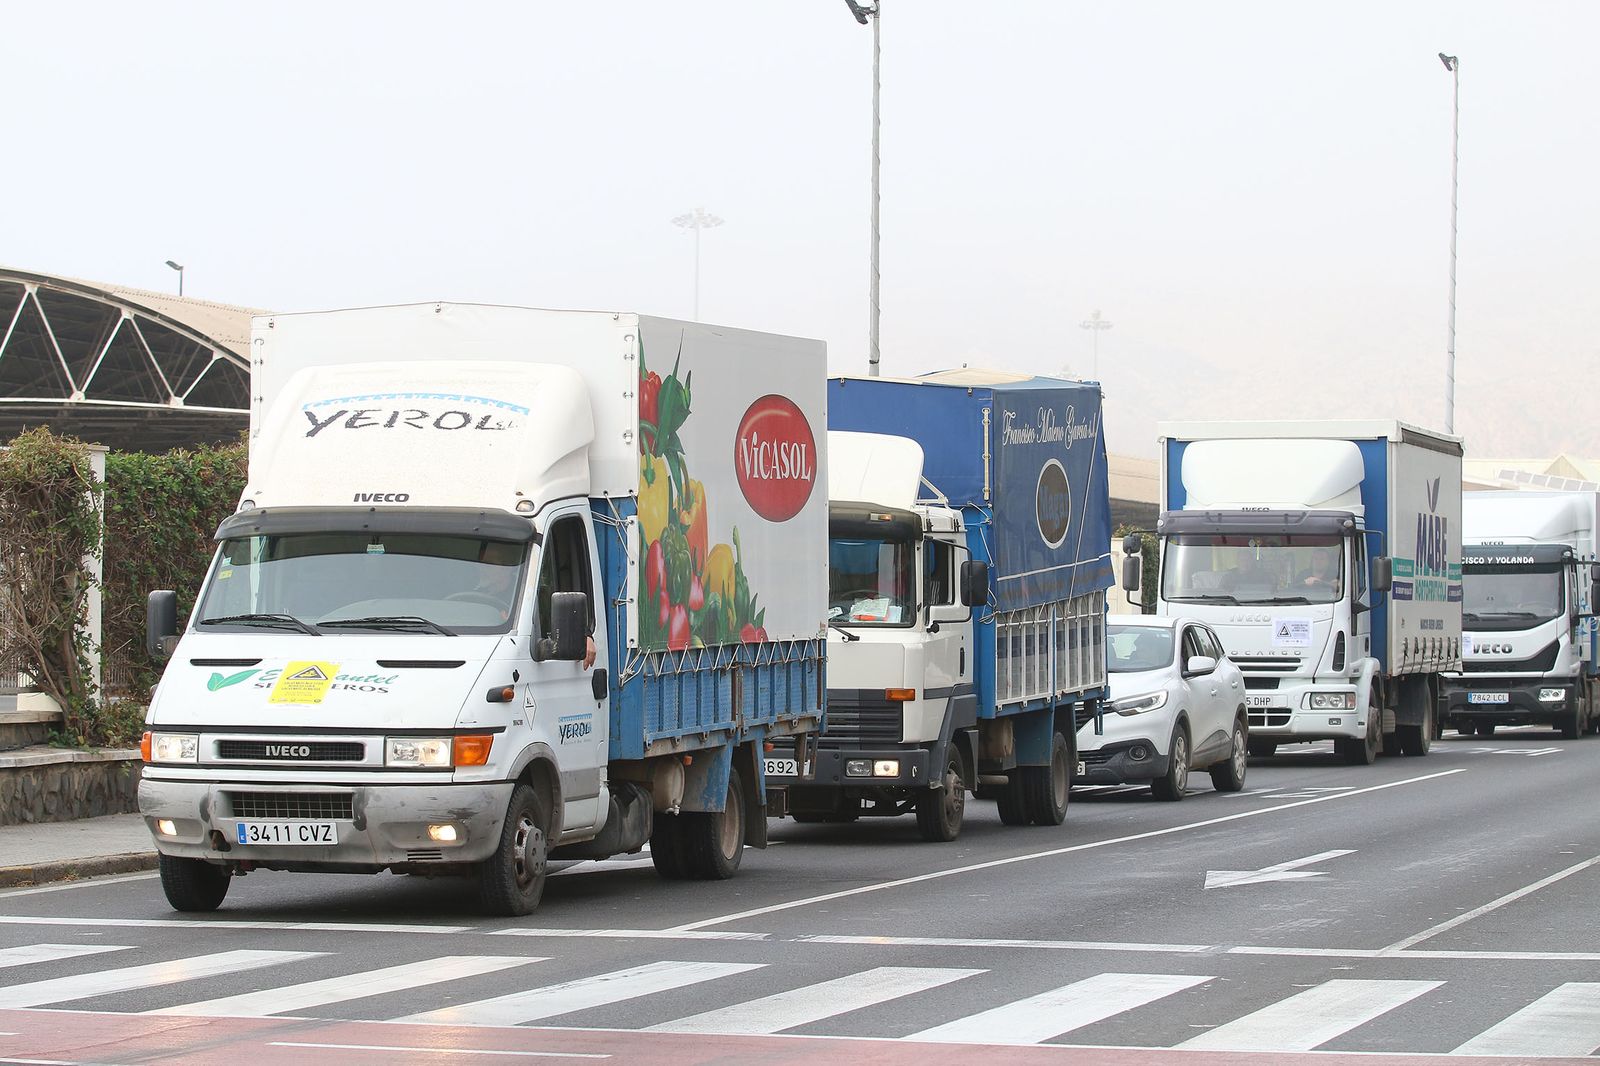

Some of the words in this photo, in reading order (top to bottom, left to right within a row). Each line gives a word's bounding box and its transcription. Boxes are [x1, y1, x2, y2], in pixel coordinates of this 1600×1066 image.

[304, 409, 504, 437] YEROL
[353, 493, 409, 503] IVECO
[1415, 512, 1448, 578] MABE
[1461, 556, 1485, 564] CISCO
[1487, 556, 1493, 564] Y
[1495, 556, 1534, 564] YOLANDA
[1230, 614, 1272, 623] IVECO
[1473, 643, 1513, 655] VECO
[1254, 697, 1271, 706] DHP
[559, 722, 592, 745] YEROL
[265, 745, 311, 757] IVECO
[763, 760, 794, 774] 692
[249, 825, 291, 842] 3411
[299, 825, 332, 842] CVZ
